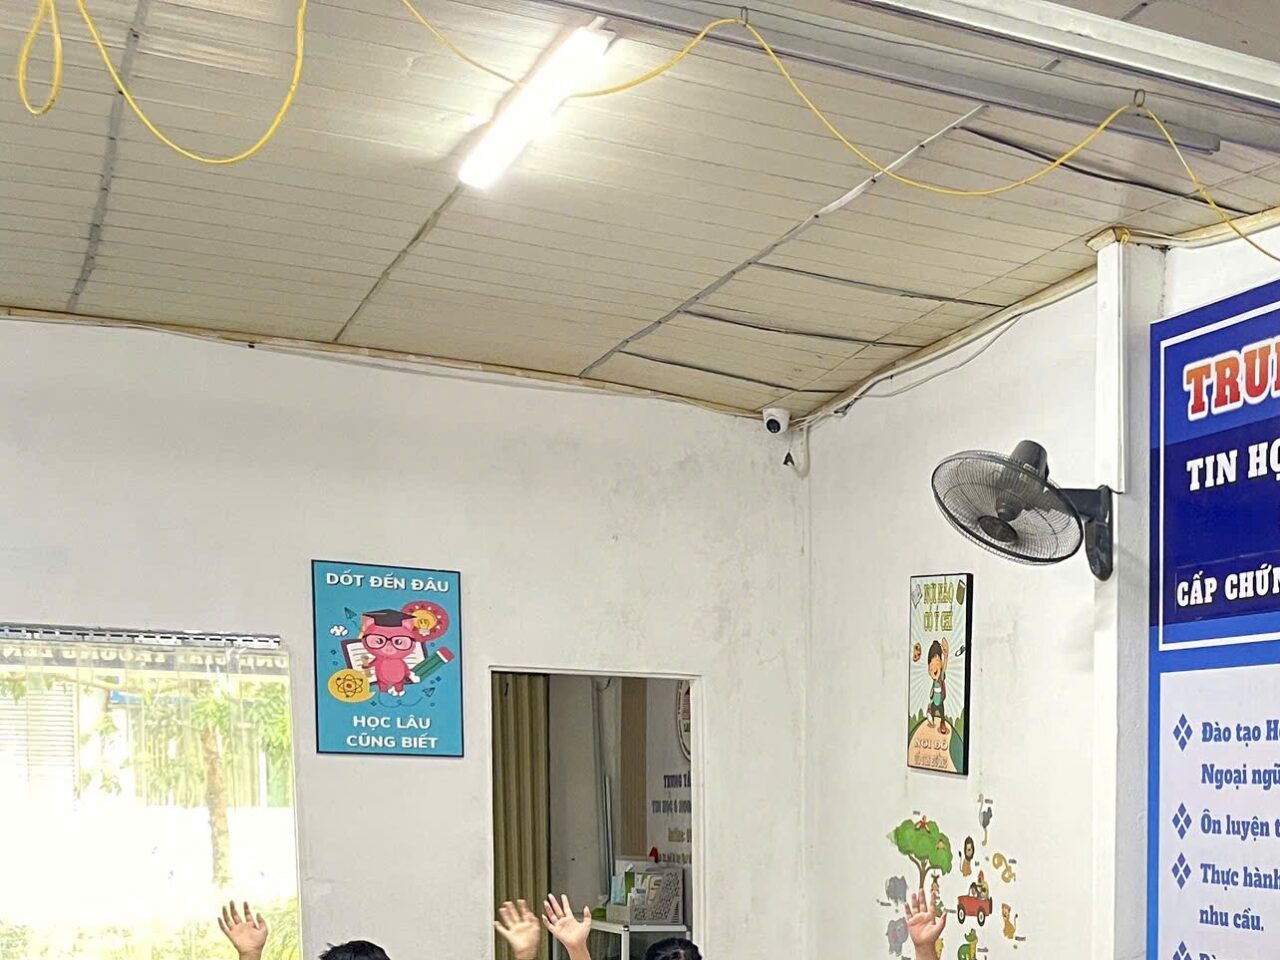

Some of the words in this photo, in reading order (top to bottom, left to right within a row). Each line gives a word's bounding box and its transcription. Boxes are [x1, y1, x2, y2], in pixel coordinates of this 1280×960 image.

[1186, 449, 1238, 491] TIN
[326, 569, 365, 587] DỐT
[369, 572, 406, 590] ĐẾN
[410, 577, 449, 592] ĐÂU
[1176, 570, 1218, 607] CẤP
[353, 715, 391, 731] HỌC
[396, 714, 431, 729] LÂU
[1201, 721, 1231, 742] Đào
[1236, 723, 1261, 747] tạo
[346, 732, 396, 748] CŨNG
[401, 732, 438, 749] BIẾT
[1201, 763, 1247, 790] Ngoại
[1200, 808, 1221, 834] Ôn
[1226, 814, 1270, 841] luyện
[1200, 863, 1239, 891] Thực
[1199, 905, 1228, 927] nhu
[1233, 907, 1264, 931] cầu.
